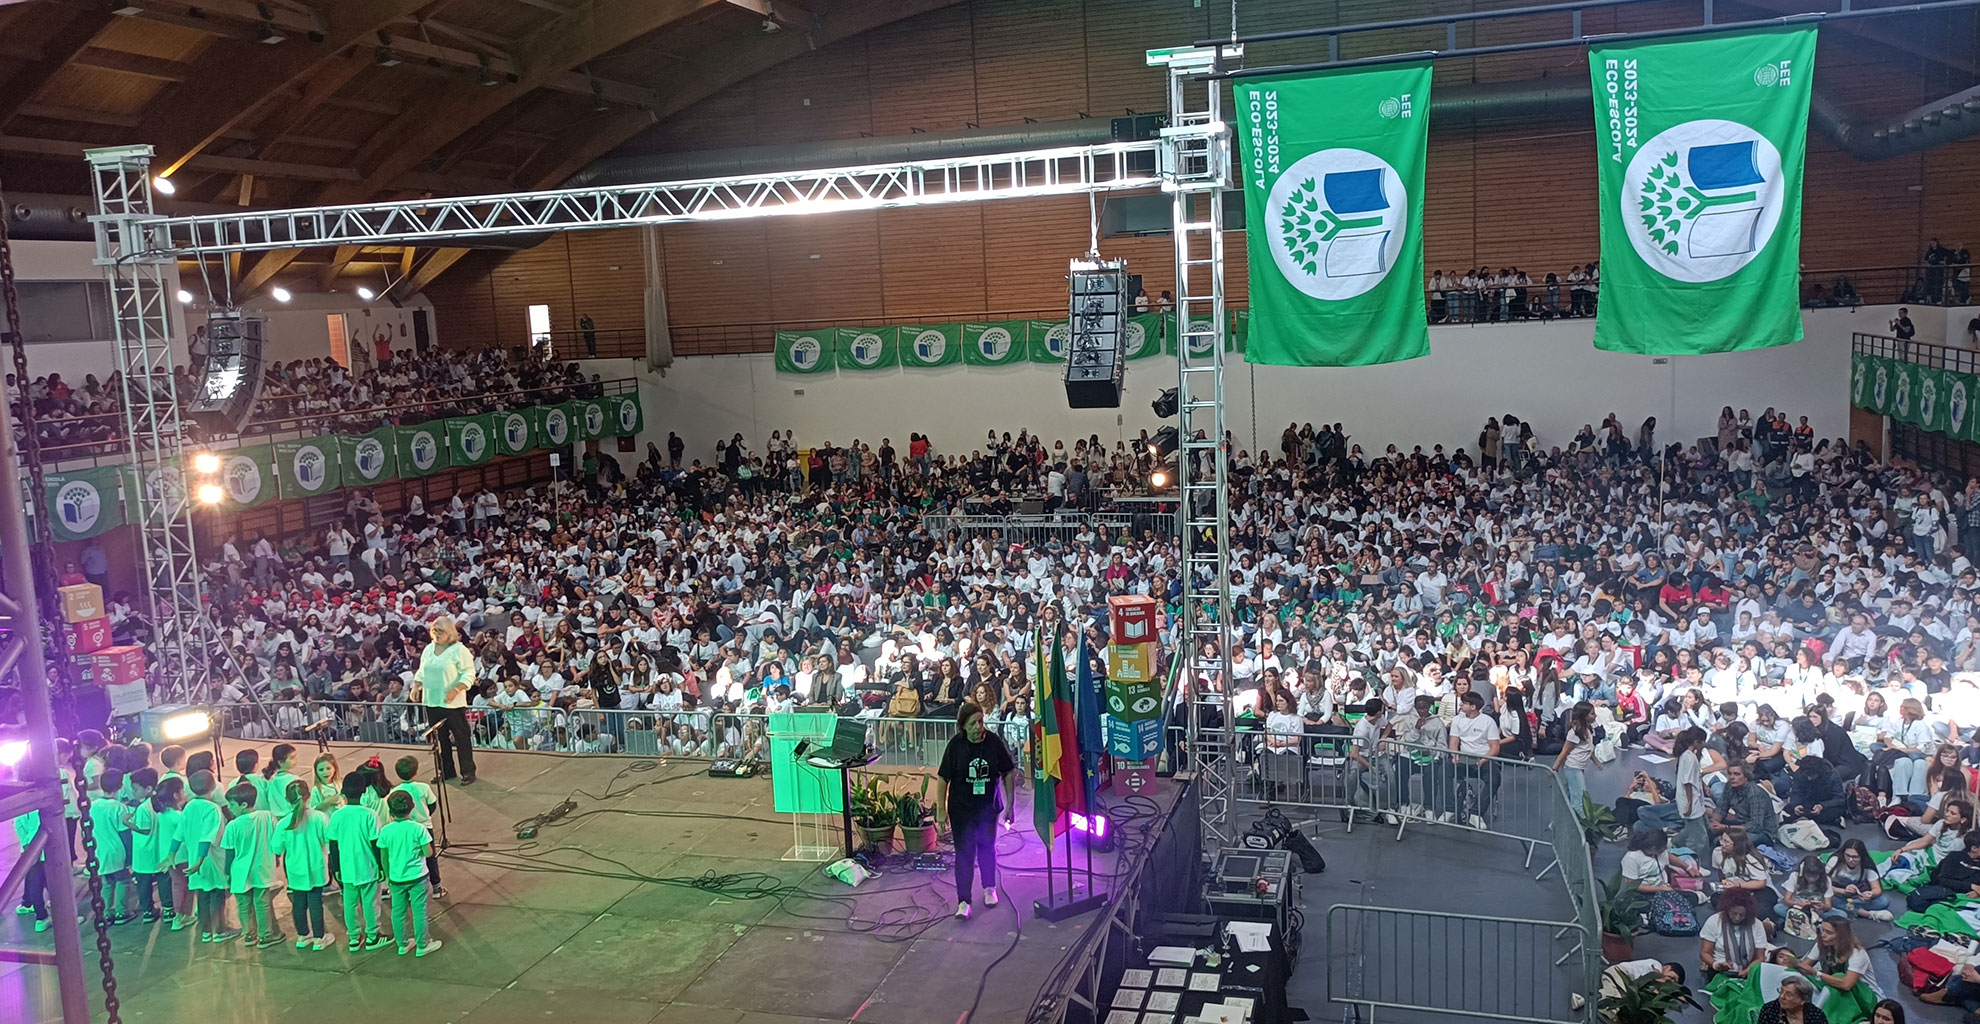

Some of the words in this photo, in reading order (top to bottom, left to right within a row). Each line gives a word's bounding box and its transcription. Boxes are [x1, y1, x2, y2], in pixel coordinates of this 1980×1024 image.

[1118, 607, 1124, 617] 4
[83, 623, 88, 631] 5
[1110, 644, 1117, 654] 11
[1128, 685, 1136, 695] 13
[1108, 719, 1115, 729] 14
[1116, 761, 1125, 770] 10
